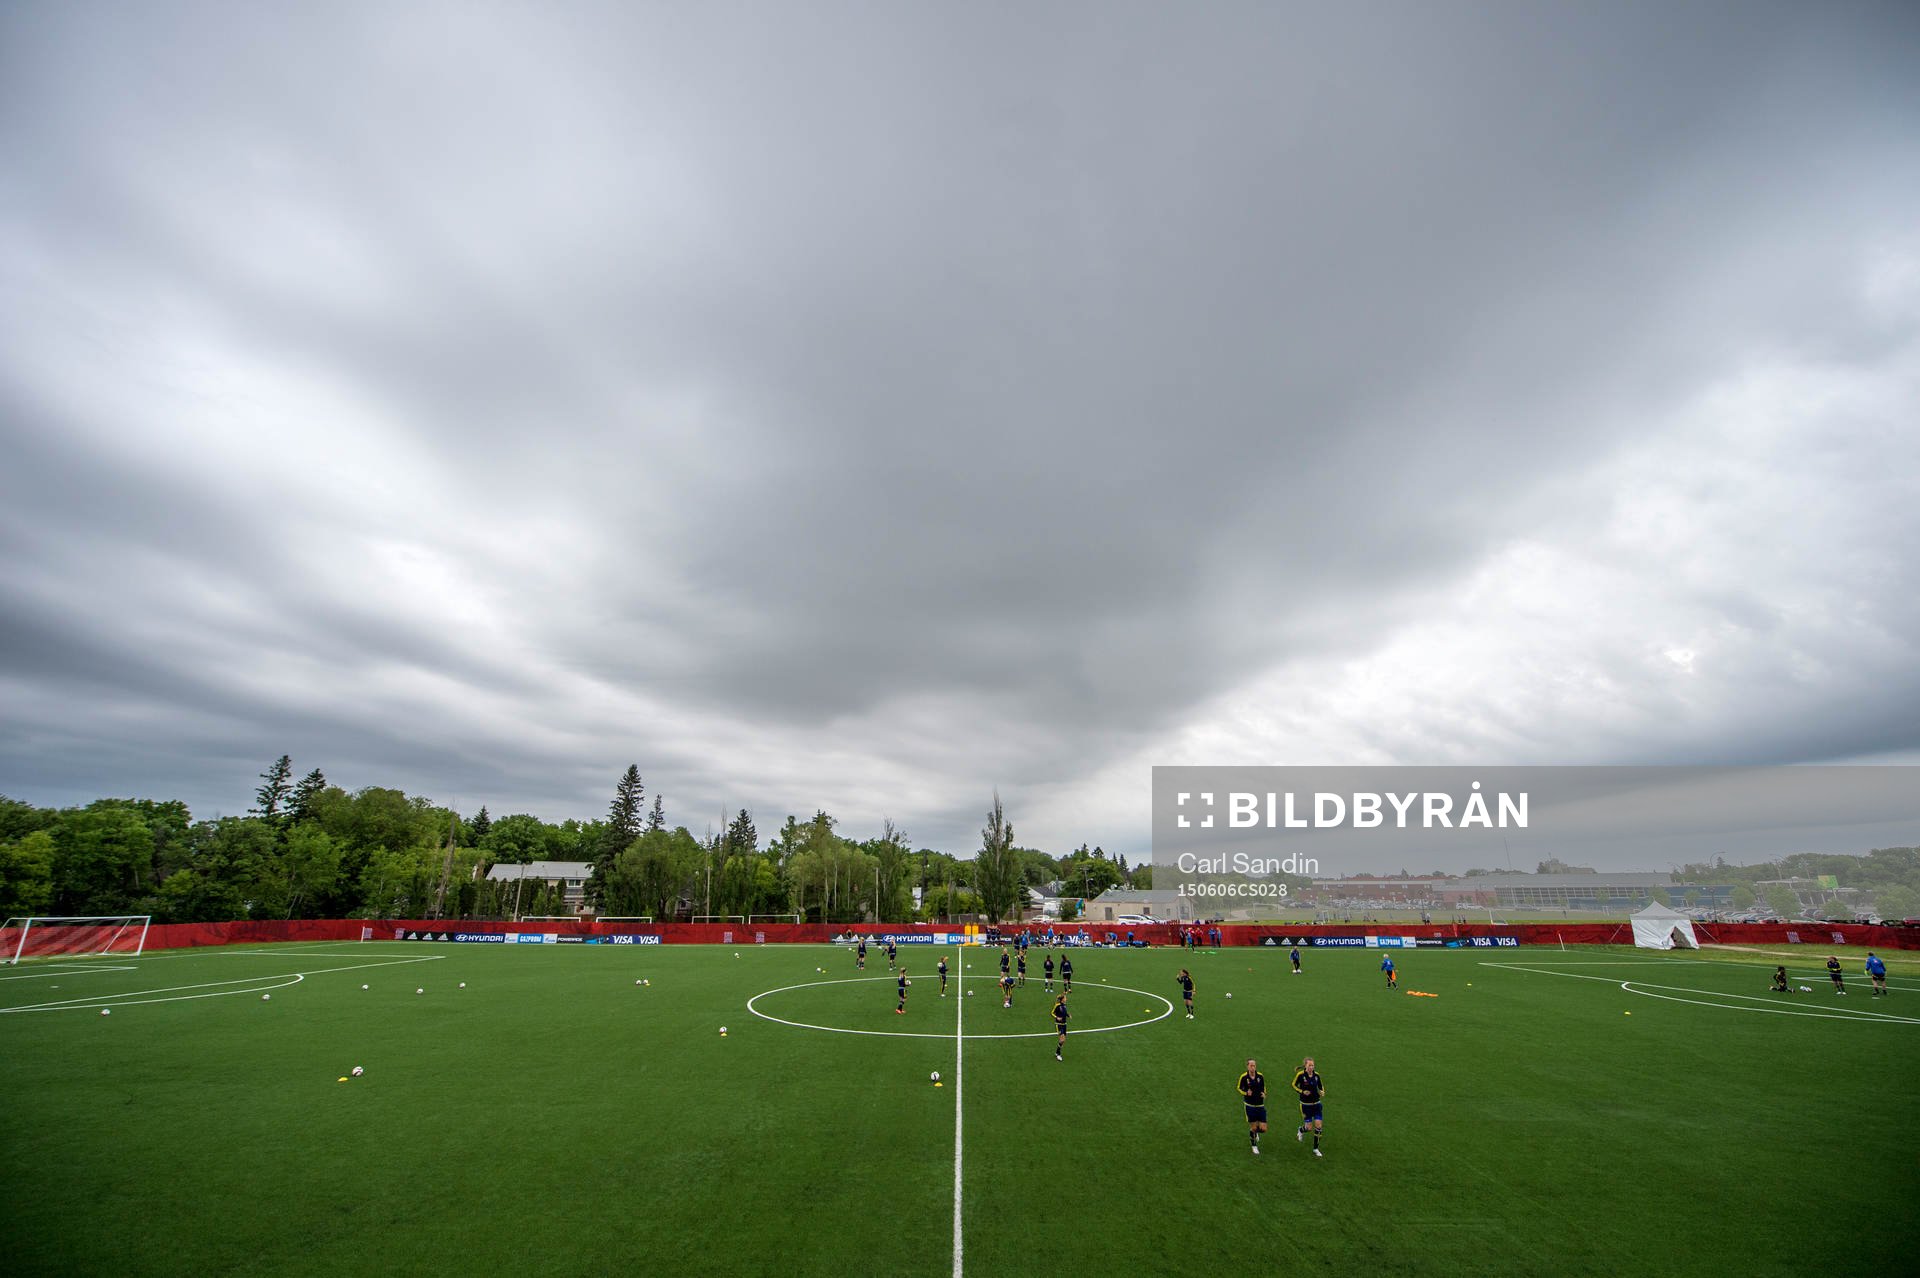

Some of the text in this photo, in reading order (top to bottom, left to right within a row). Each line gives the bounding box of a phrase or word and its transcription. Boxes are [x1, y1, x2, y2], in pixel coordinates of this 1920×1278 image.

[612, 935, 659, 944] VISA VISA
[1472, 937, 1517, 946] VISA VISA
